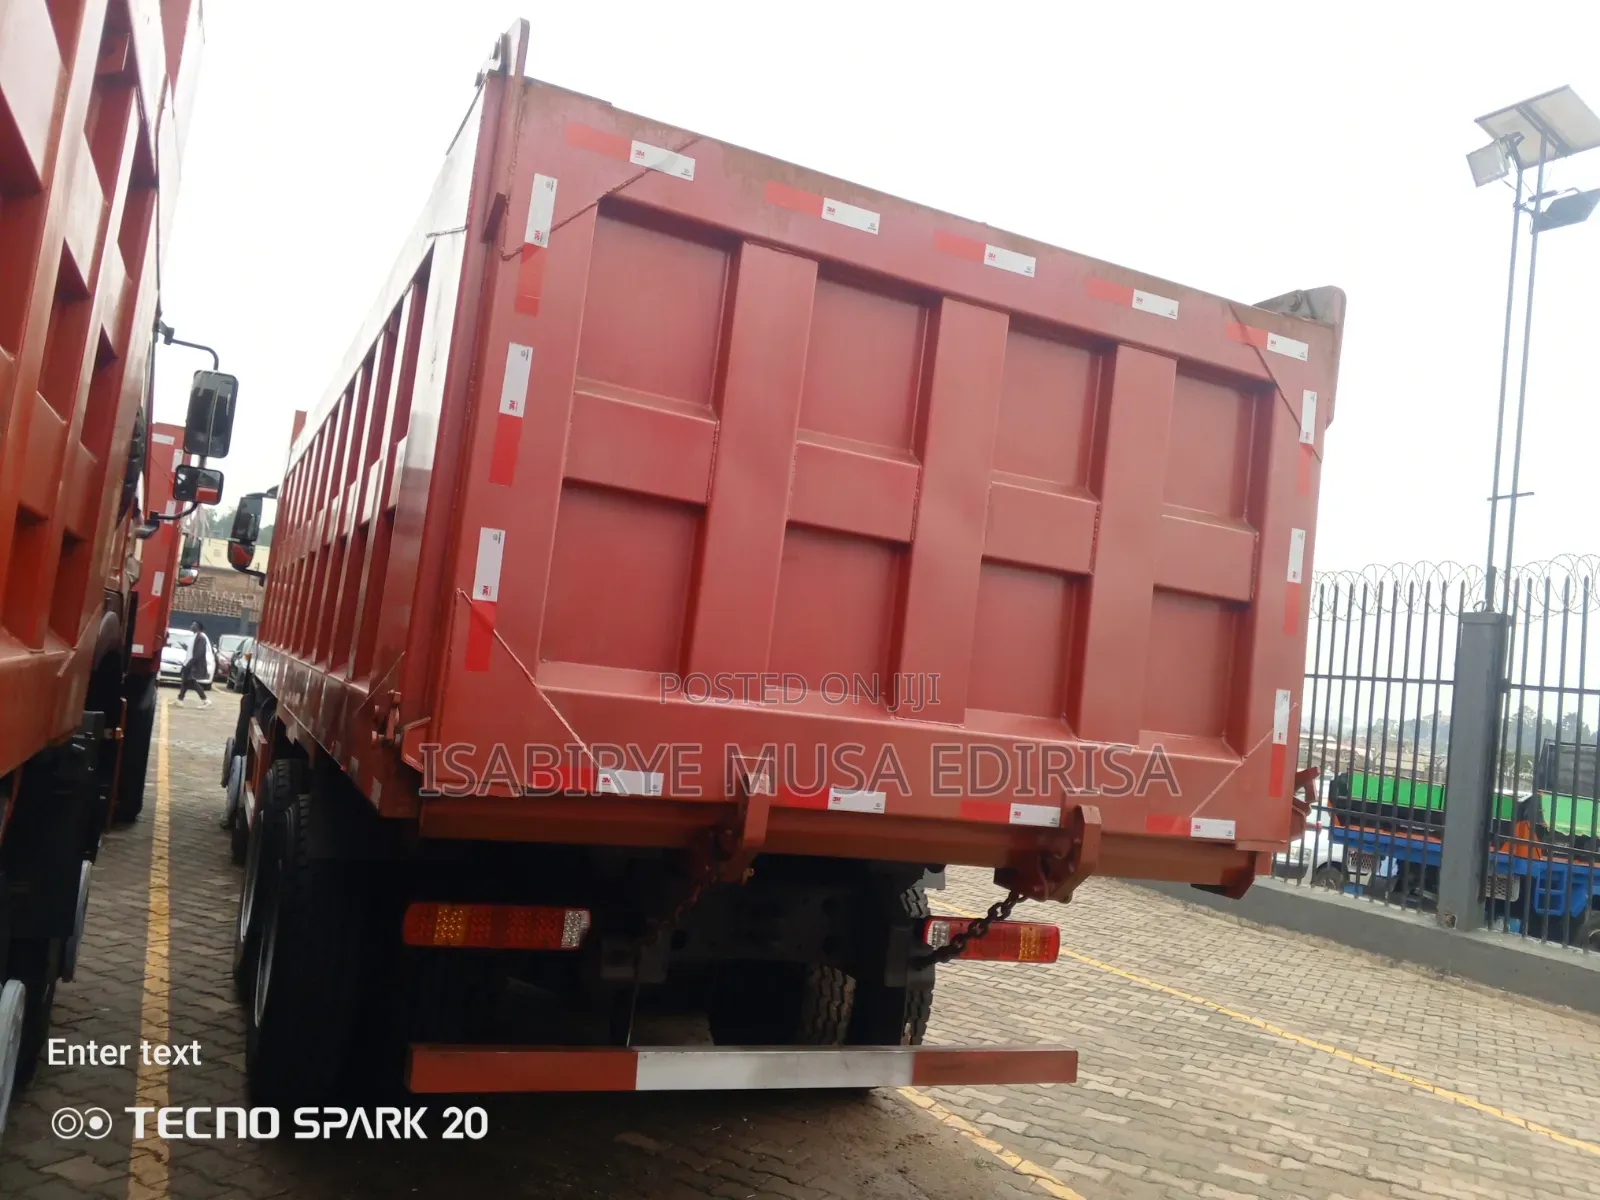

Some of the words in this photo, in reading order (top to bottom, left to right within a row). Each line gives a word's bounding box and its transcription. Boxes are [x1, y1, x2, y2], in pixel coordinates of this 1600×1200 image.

[635, 149, 645, 157] 3M
[509, 400, 516, 411] 3M
[482, 585, 489, 596] 3M
